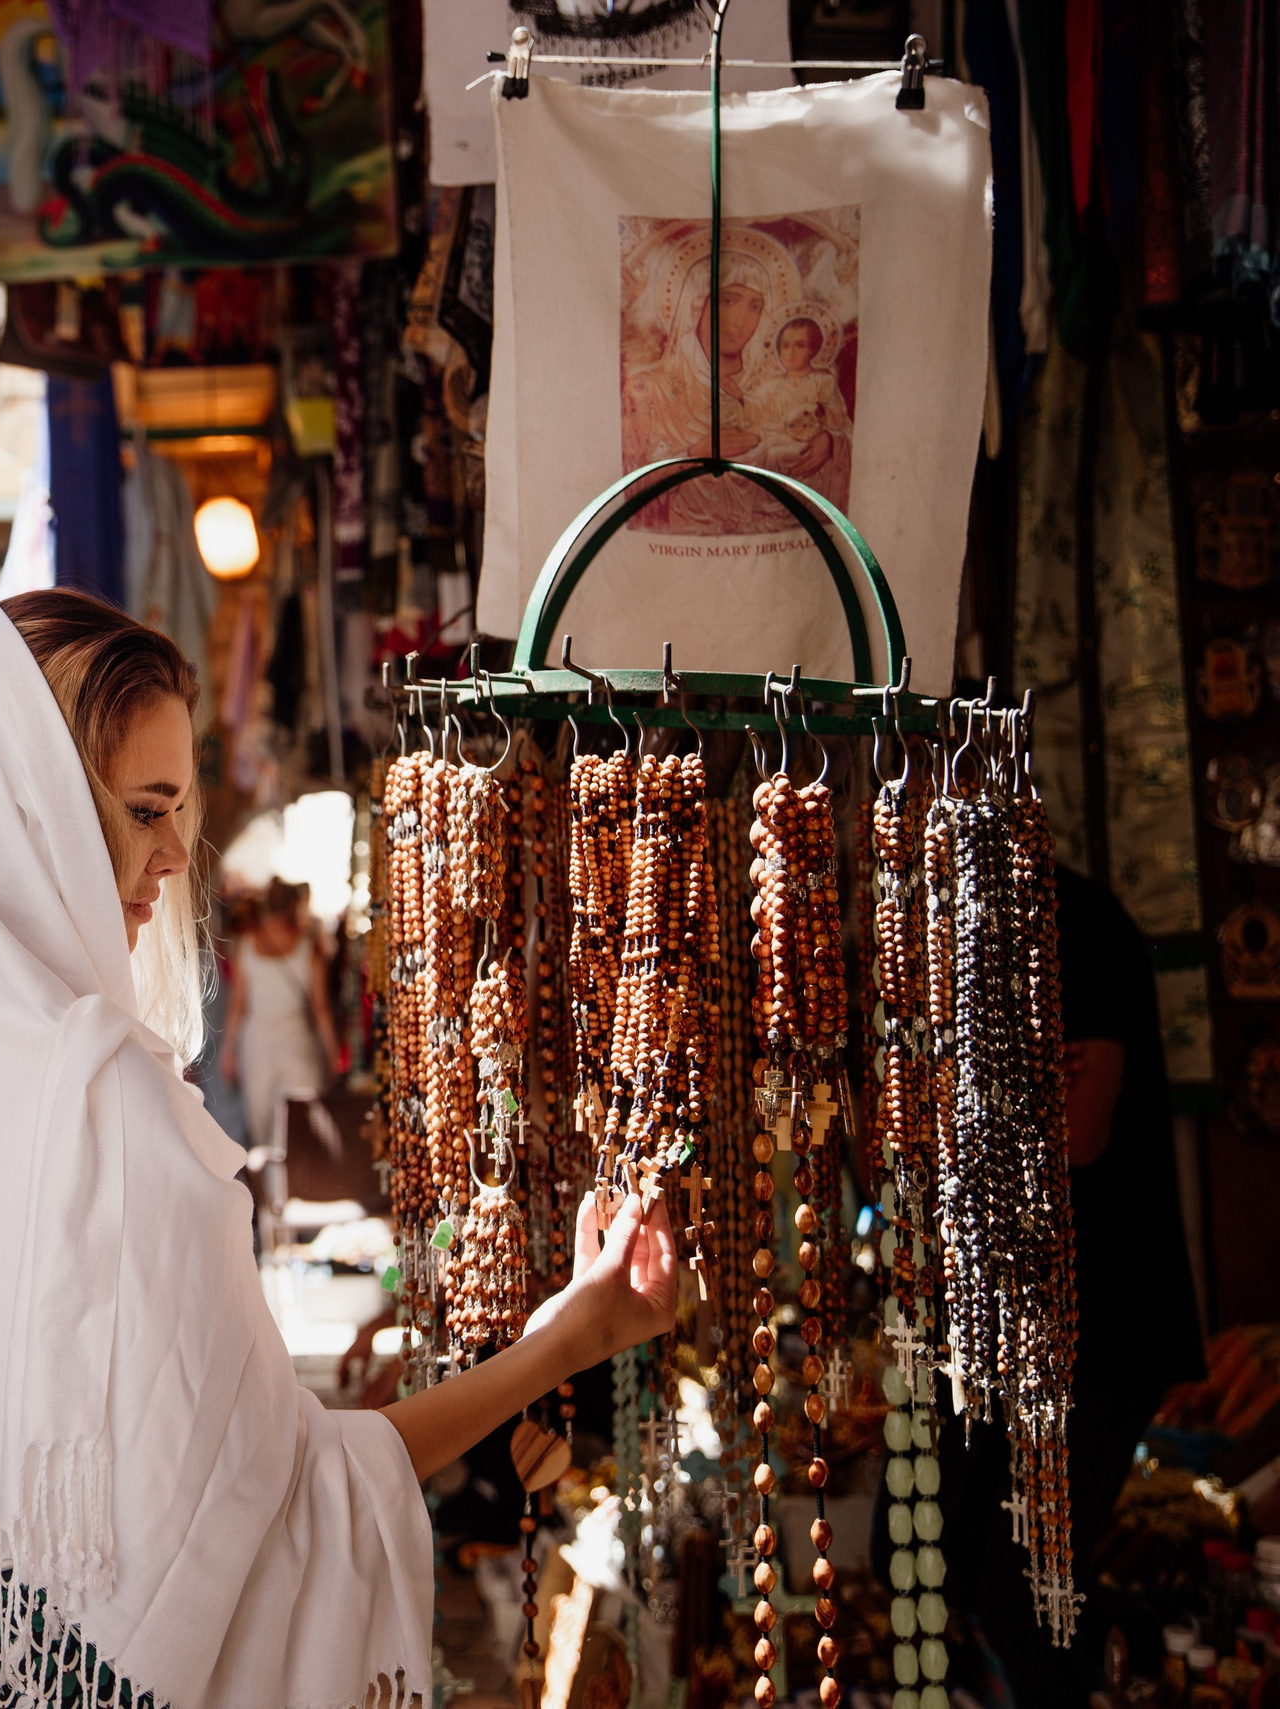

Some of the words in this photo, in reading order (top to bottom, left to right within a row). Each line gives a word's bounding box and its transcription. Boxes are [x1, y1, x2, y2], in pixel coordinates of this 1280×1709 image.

[648, 543, 702, 558] VIRGIN
[706, 544, 751, 557] MARY
[756, 533, 833, 556] JERUSAL
